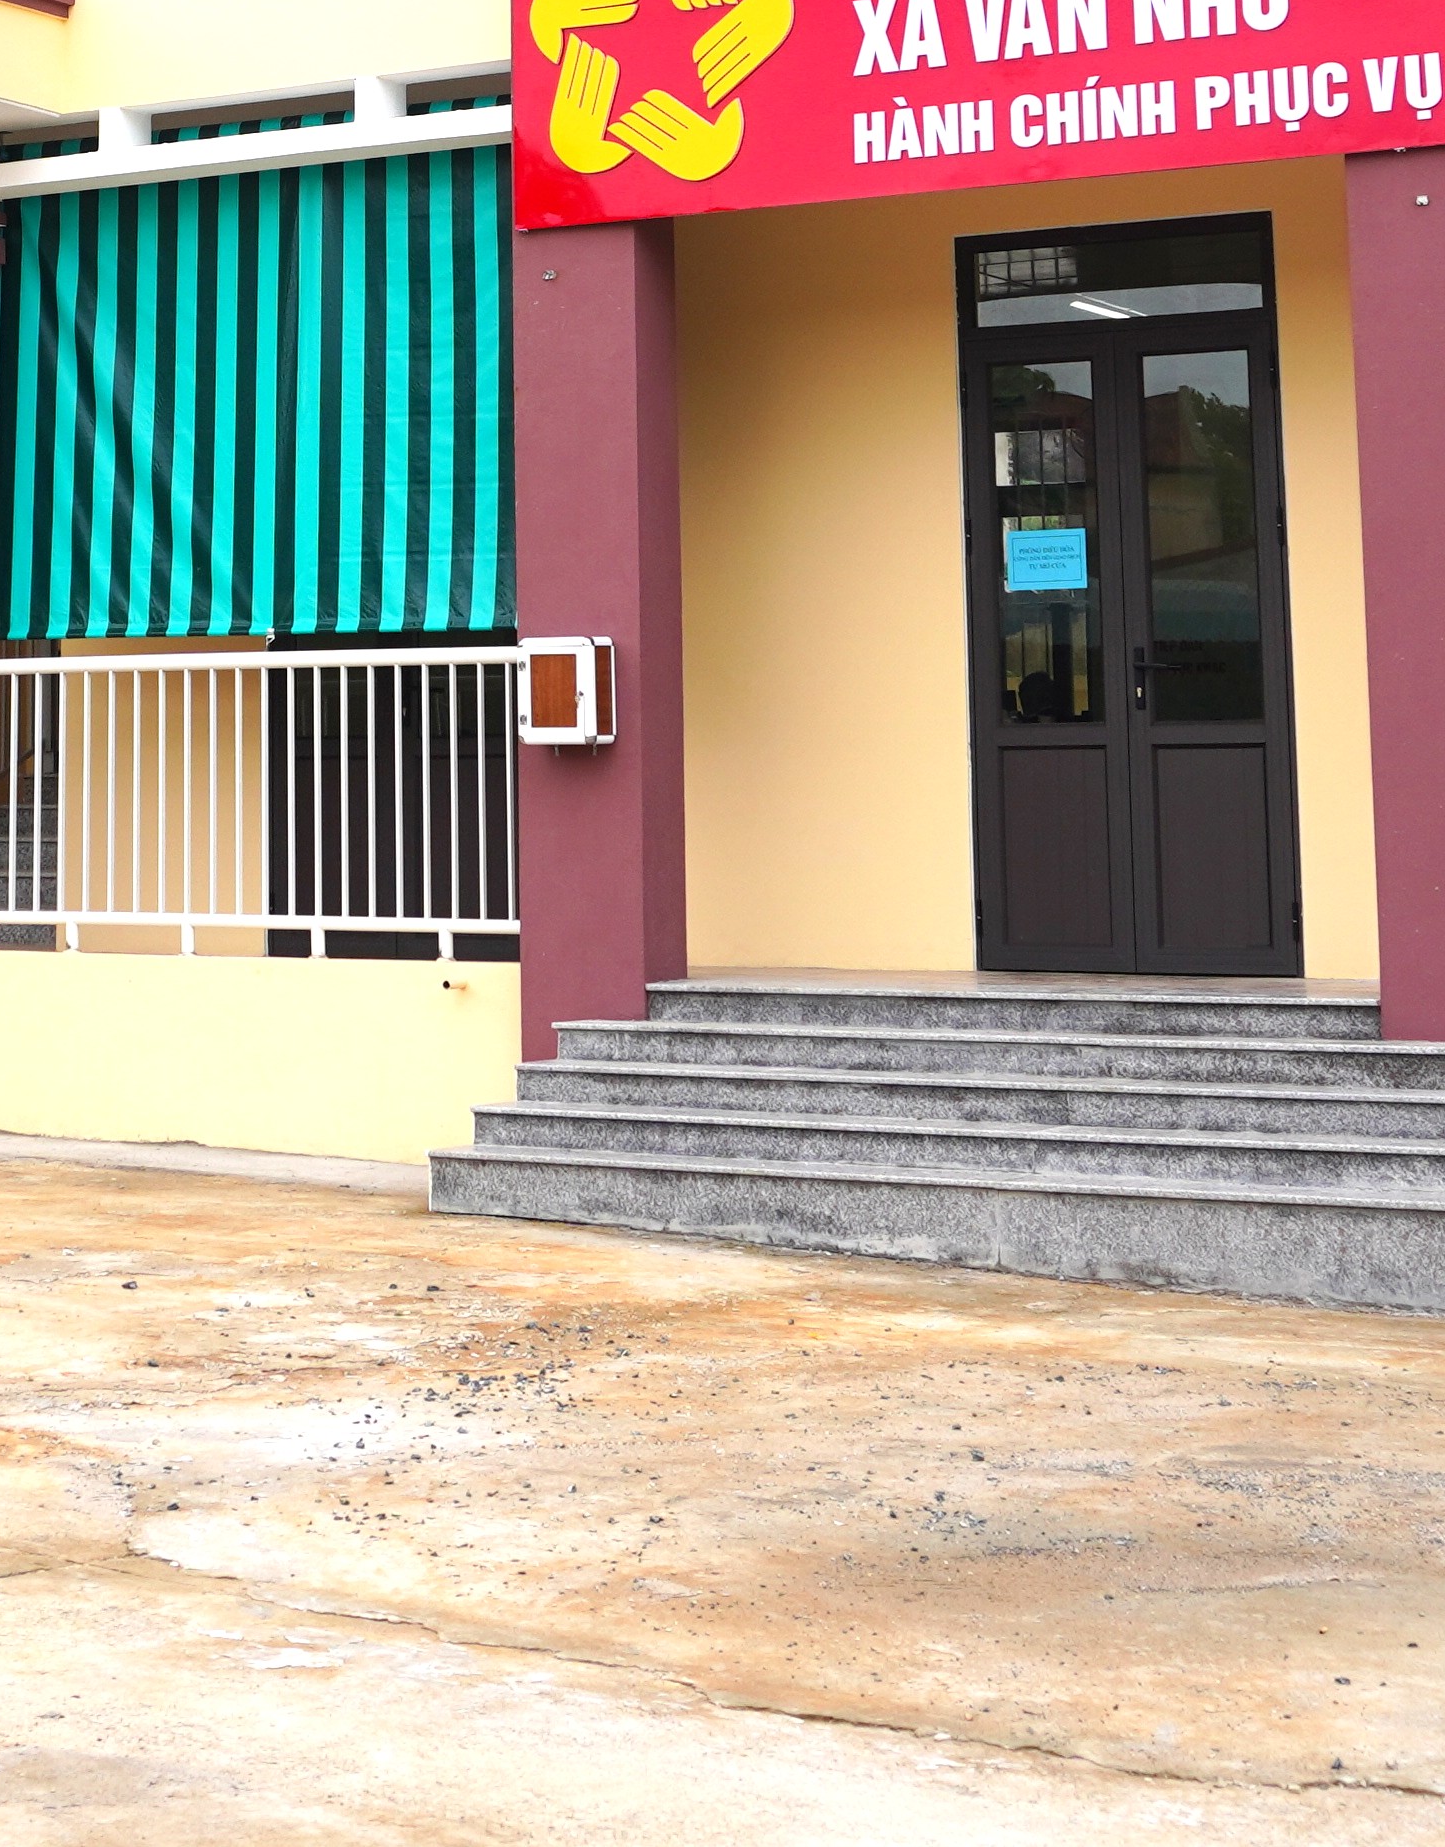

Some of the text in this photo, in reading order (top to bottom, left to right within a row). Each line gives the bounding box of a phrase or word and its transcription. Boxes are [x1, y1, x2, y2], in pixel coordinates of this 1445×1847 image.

[854, 53, 1442, 163] HÀNH CHÍNH PHỤC VỤ
